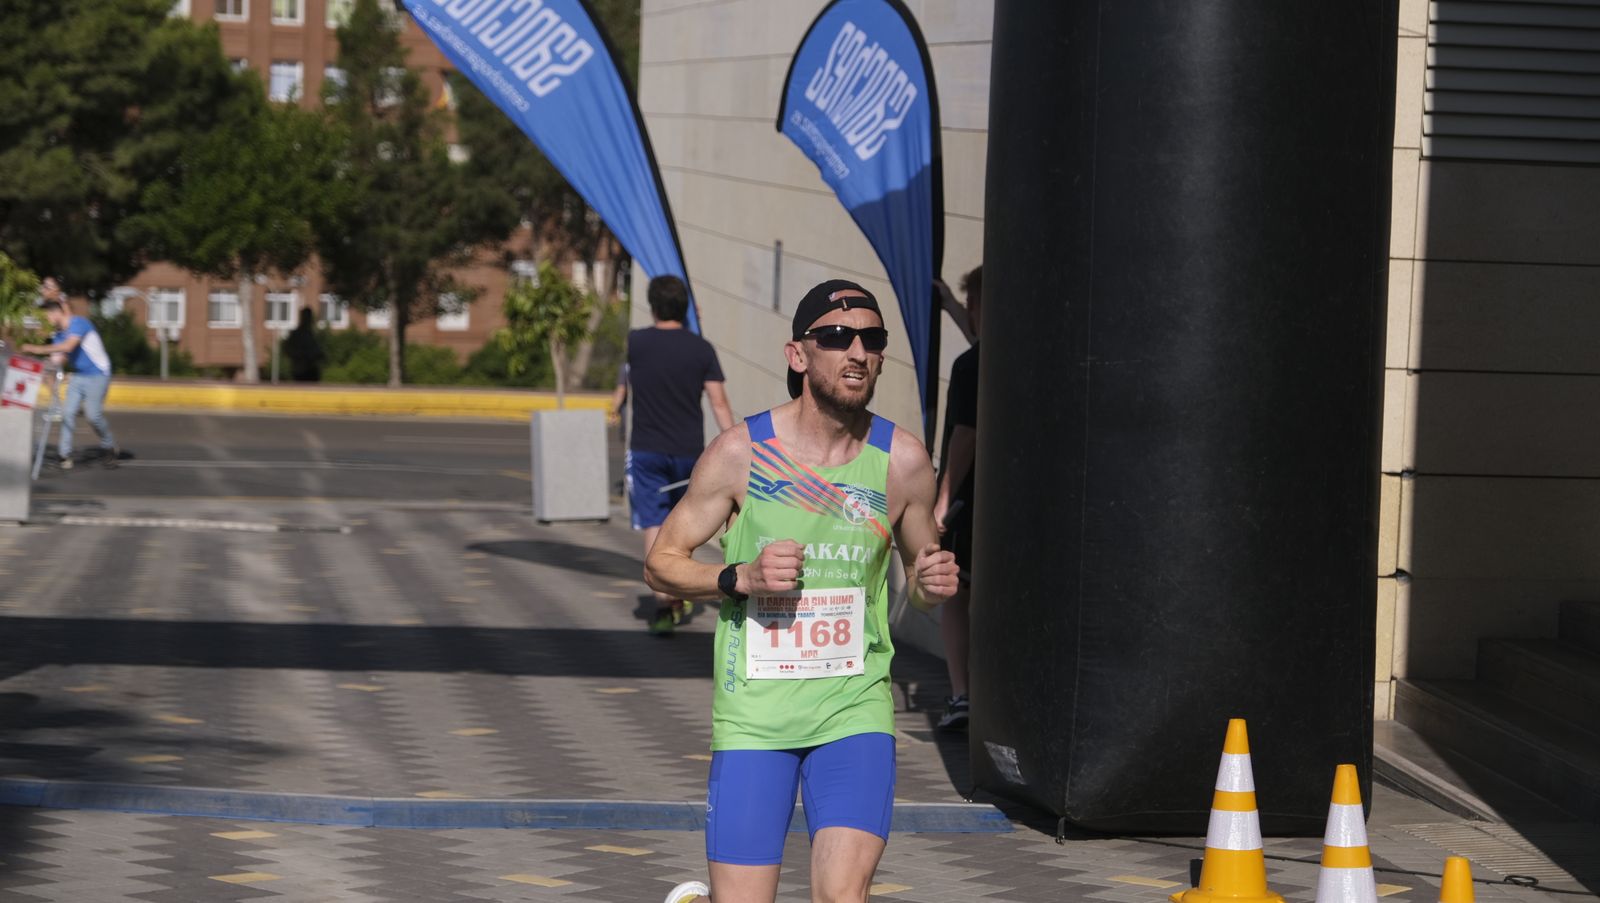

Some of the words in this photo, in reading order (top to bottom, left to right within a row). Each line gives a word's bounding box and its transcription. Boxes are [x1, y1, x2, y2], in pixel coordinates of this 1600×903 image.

[803, 543, 872, 563] AKATA
[766, 596, 809, 607] CARRERA
[811, 595, 828, 606] SIN
[829, 594, 854, 606] HUMO
[762, 618, 852, 648] 1168
